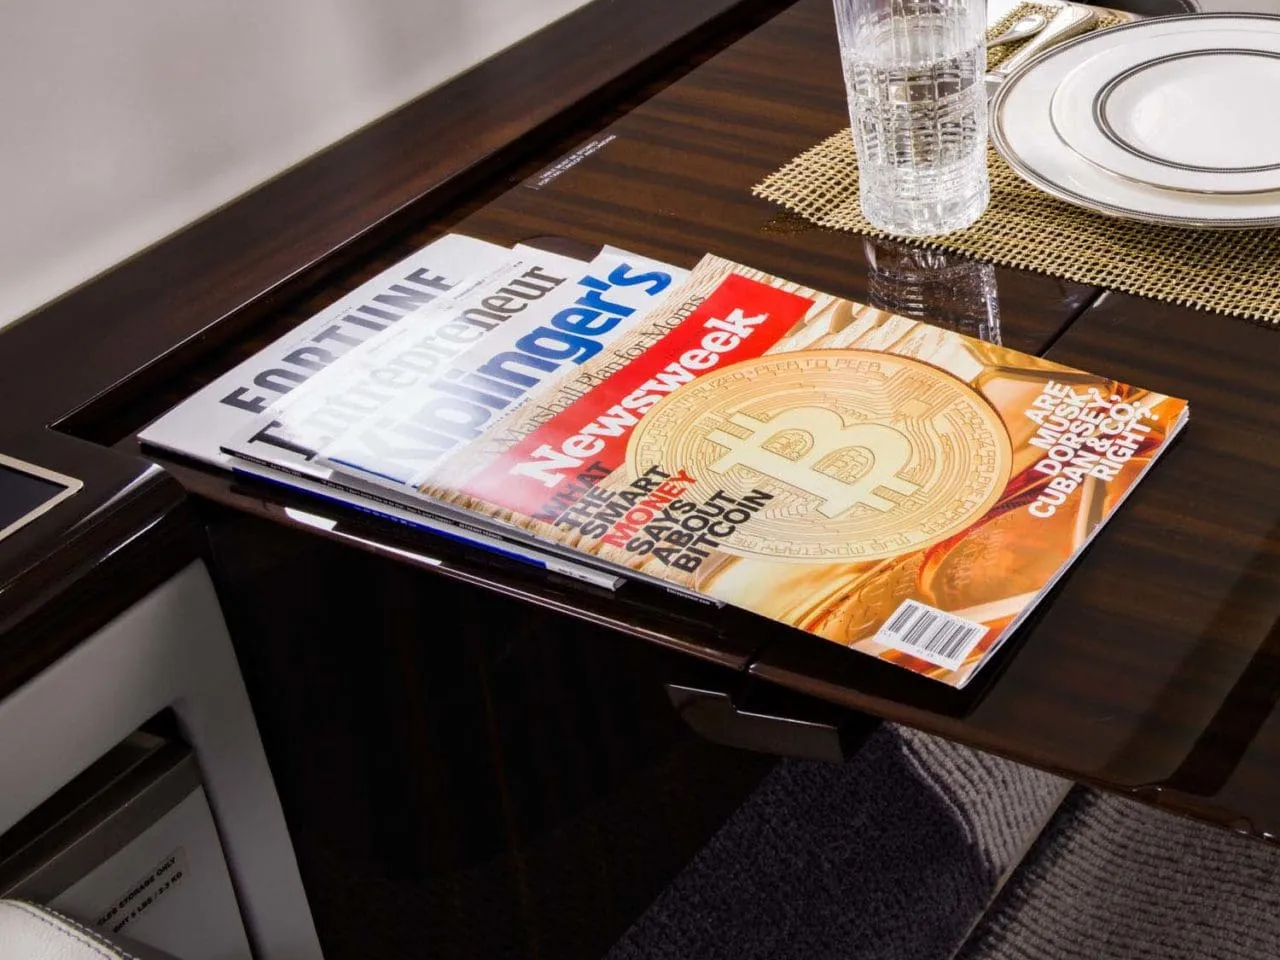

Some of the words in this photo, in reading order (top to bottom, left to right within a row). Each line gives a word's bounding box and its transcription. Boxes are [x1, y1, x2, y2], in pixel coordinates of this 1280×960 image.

[219, 267, 457, 414] FORTUNE
[345, 262, 673, 476] Kiplinger's
[495, 384, 589, 445] Marshall
[575, 361, 624, 391] Plan
[613, 340, 651, 364] for
[640, 294, 706, 342] Moms
[511, 307, 769, 488] Newsweek
[1023, 380, 1067, 425] ARE
[1028, 385, 1099, 450] MUSK,
[1034, 394, 1122, 477] DORSEY,
[1028, 449, 1105, 518] CUBAN
[1085, 438, 1112, 453] &
[1099, 401, 1140, 436] CO.
[1089, 407, 1159, 482] RIGHT?
[533, 460, 613, 522] WHAT
[554, 486, 616, 531] THE
[580, 464, 671, 539] SMART
[601, 468, 697, 549] MONEY
[626, 498, 698, 556] SAYS
[651, 489, 738, 565] ABOUT
[671, 488, 775, 574] BITCOIN
[157, 857, 176, 876] ONLY
